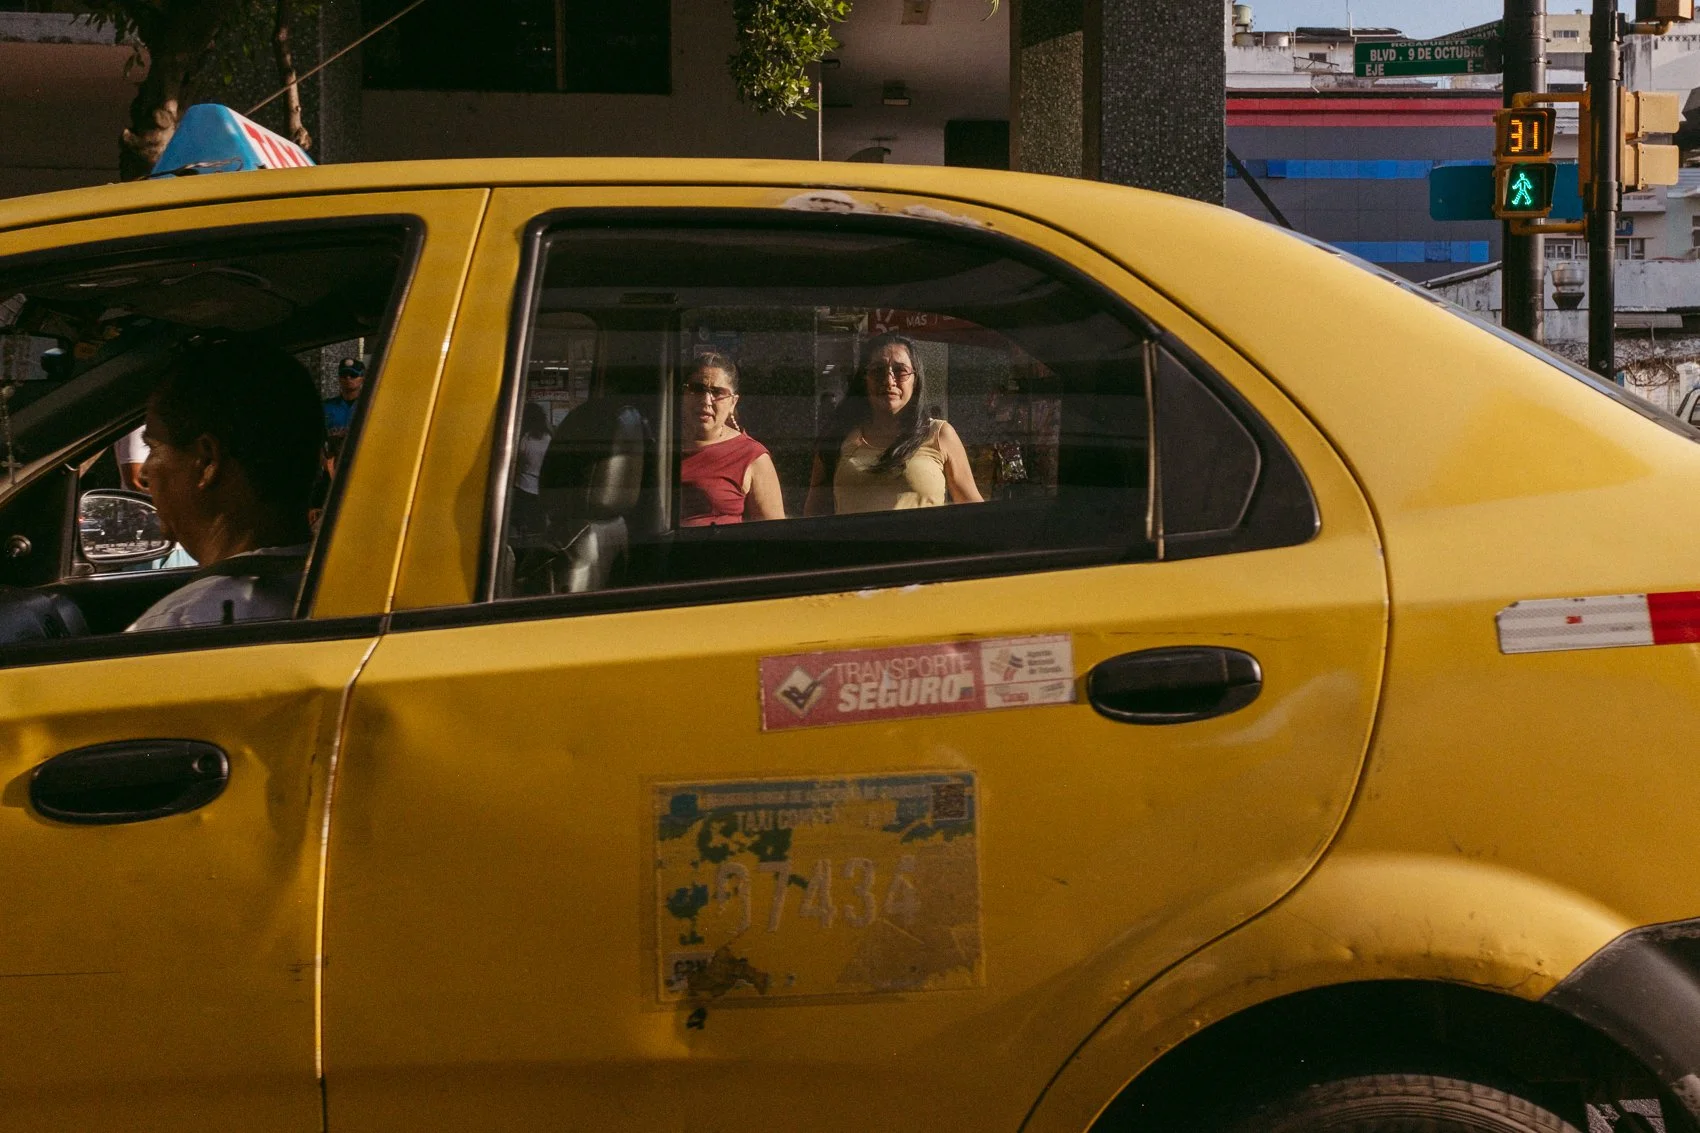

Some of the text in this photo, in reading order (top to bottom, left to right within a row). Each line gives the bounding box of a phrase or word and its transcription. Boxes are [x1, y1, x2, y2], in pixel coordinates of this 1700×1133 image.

[1408, 48, 1415, 60] 9
[1418, 47, 1432, 60] DE
[1434, 45, 1484, 59] OCTUBRE
[1365, 63, 1385, 76] EJE
[1510, 119, 1539, 152] 31
[833, 651, 972, 685] TRANSPORTE
[837, 672, 966, 712] SEGURO
